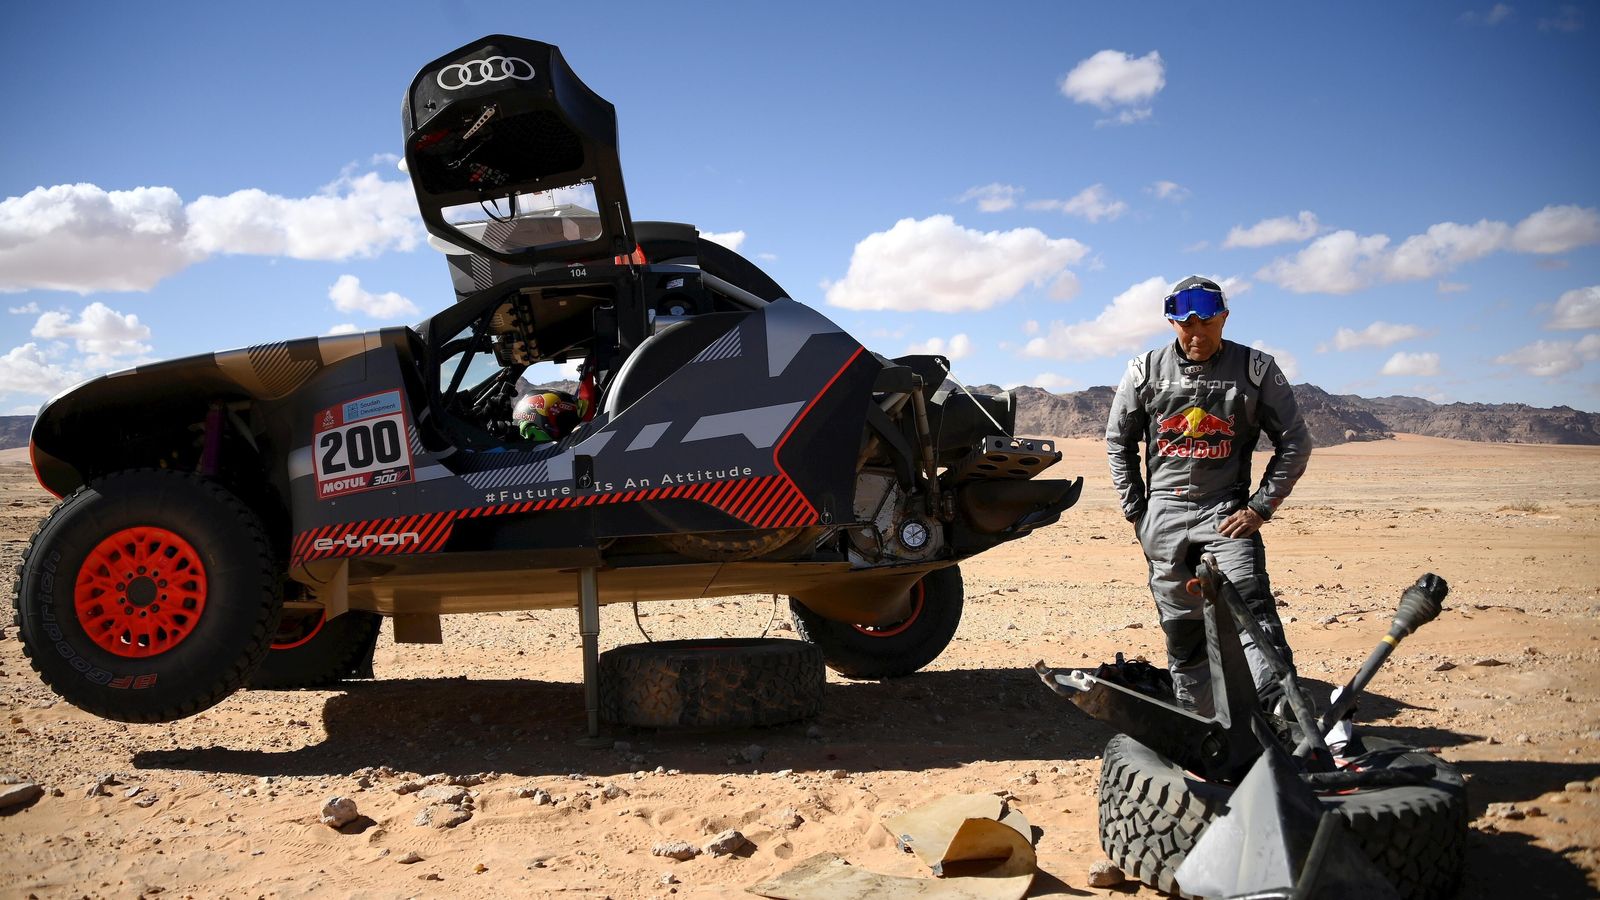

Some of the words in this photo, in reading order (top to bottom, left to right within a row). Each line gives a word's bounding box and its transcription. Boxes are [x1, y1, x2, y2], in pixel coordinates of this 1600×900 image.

[570, 268, 587, 278] 104
[360, 403, 396, 415] Development
[320, 420, 402, 476] 200
[1157, 437, 1192, 458] Red
[1192, 439, 1232, 459] Bull
[322, 476, 366, 494] MOTUL
[485, 485, 571, 503] #Future
[594, 481, 614, 492] Is
[624, 478, 650, 489] An
[661, 466, 752, 485] Attitude
[313, 531, 420, 551] e-tron
